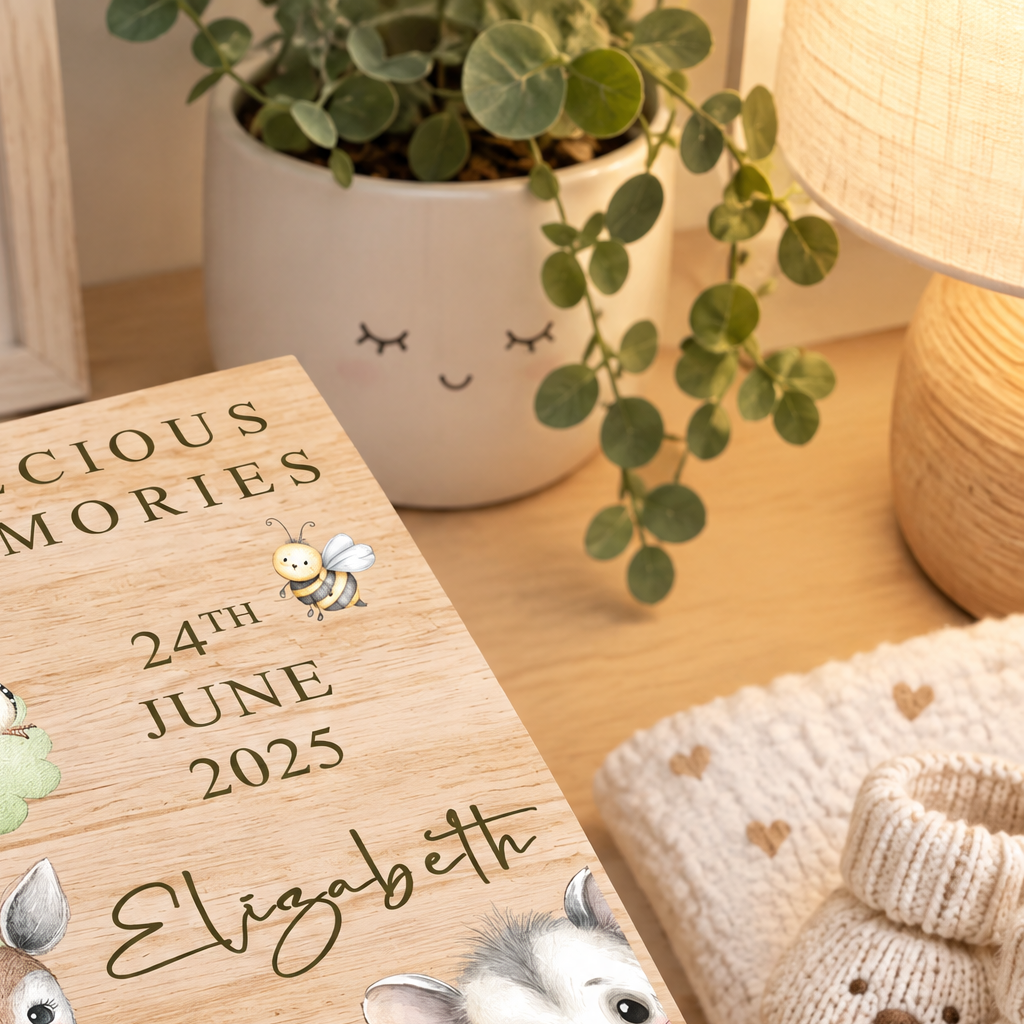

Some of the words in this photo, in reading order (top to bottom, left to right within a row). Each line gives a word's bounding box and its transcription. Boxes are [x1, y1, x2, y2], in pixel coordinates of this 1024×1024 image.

[130, 601, 263, 670] 24TH
[138, 660, 333, 740] JUNE
[189, 726, 344, 800] 2025
[106, 804, 538, 980] Elizabeth
